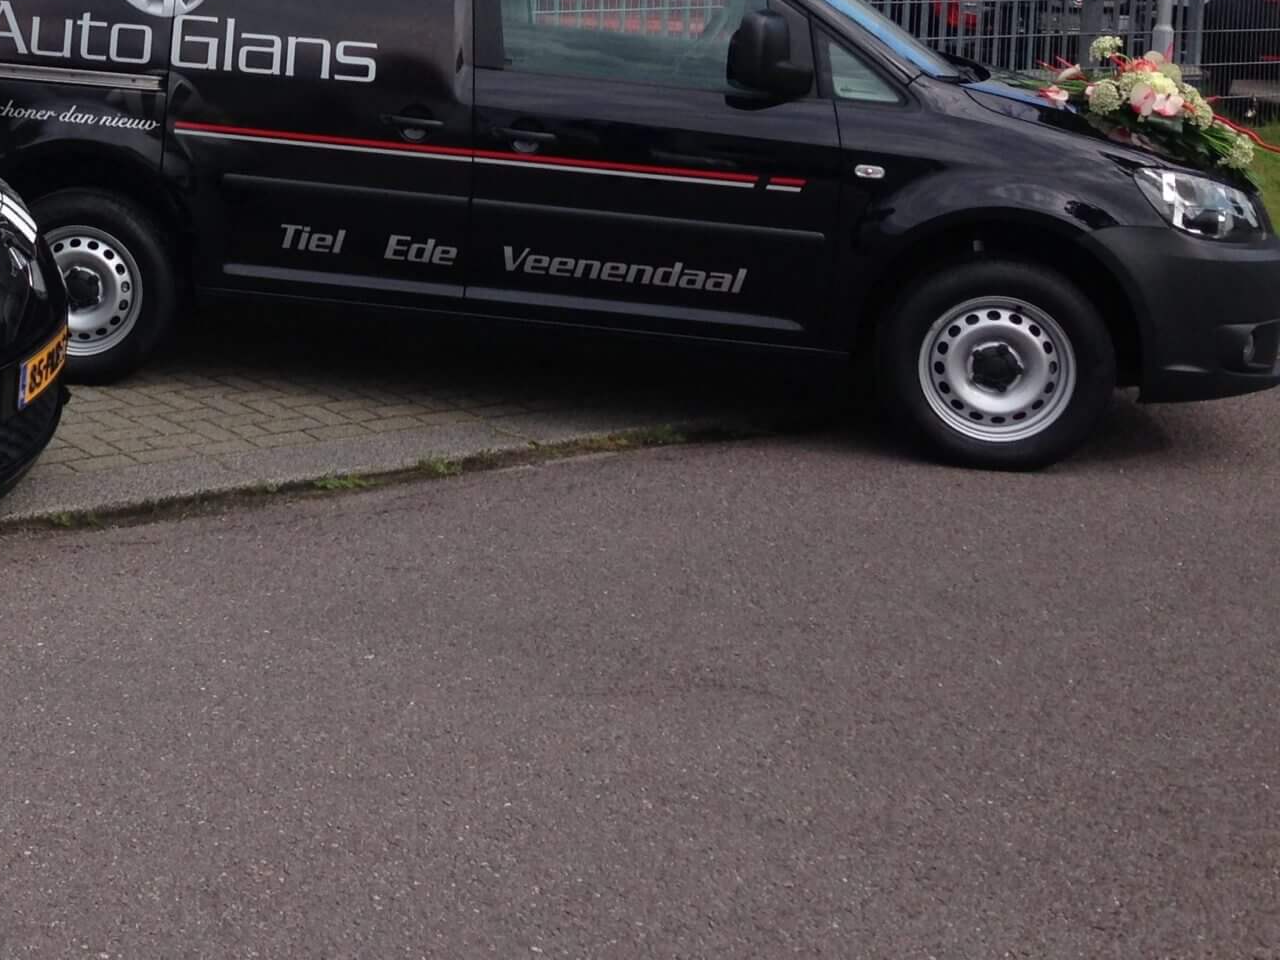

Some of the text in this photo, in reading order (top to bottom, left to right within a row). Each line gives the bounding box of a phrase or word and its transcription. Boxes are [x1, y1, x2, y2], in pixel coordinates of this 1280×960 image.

[170, 14, 378, 83] Glans
[59, 102, 98, 126] dan
[99, 110, 160, 132] nieuw
[280, 223, 747, 294] Tiel Ede Veenendaal
